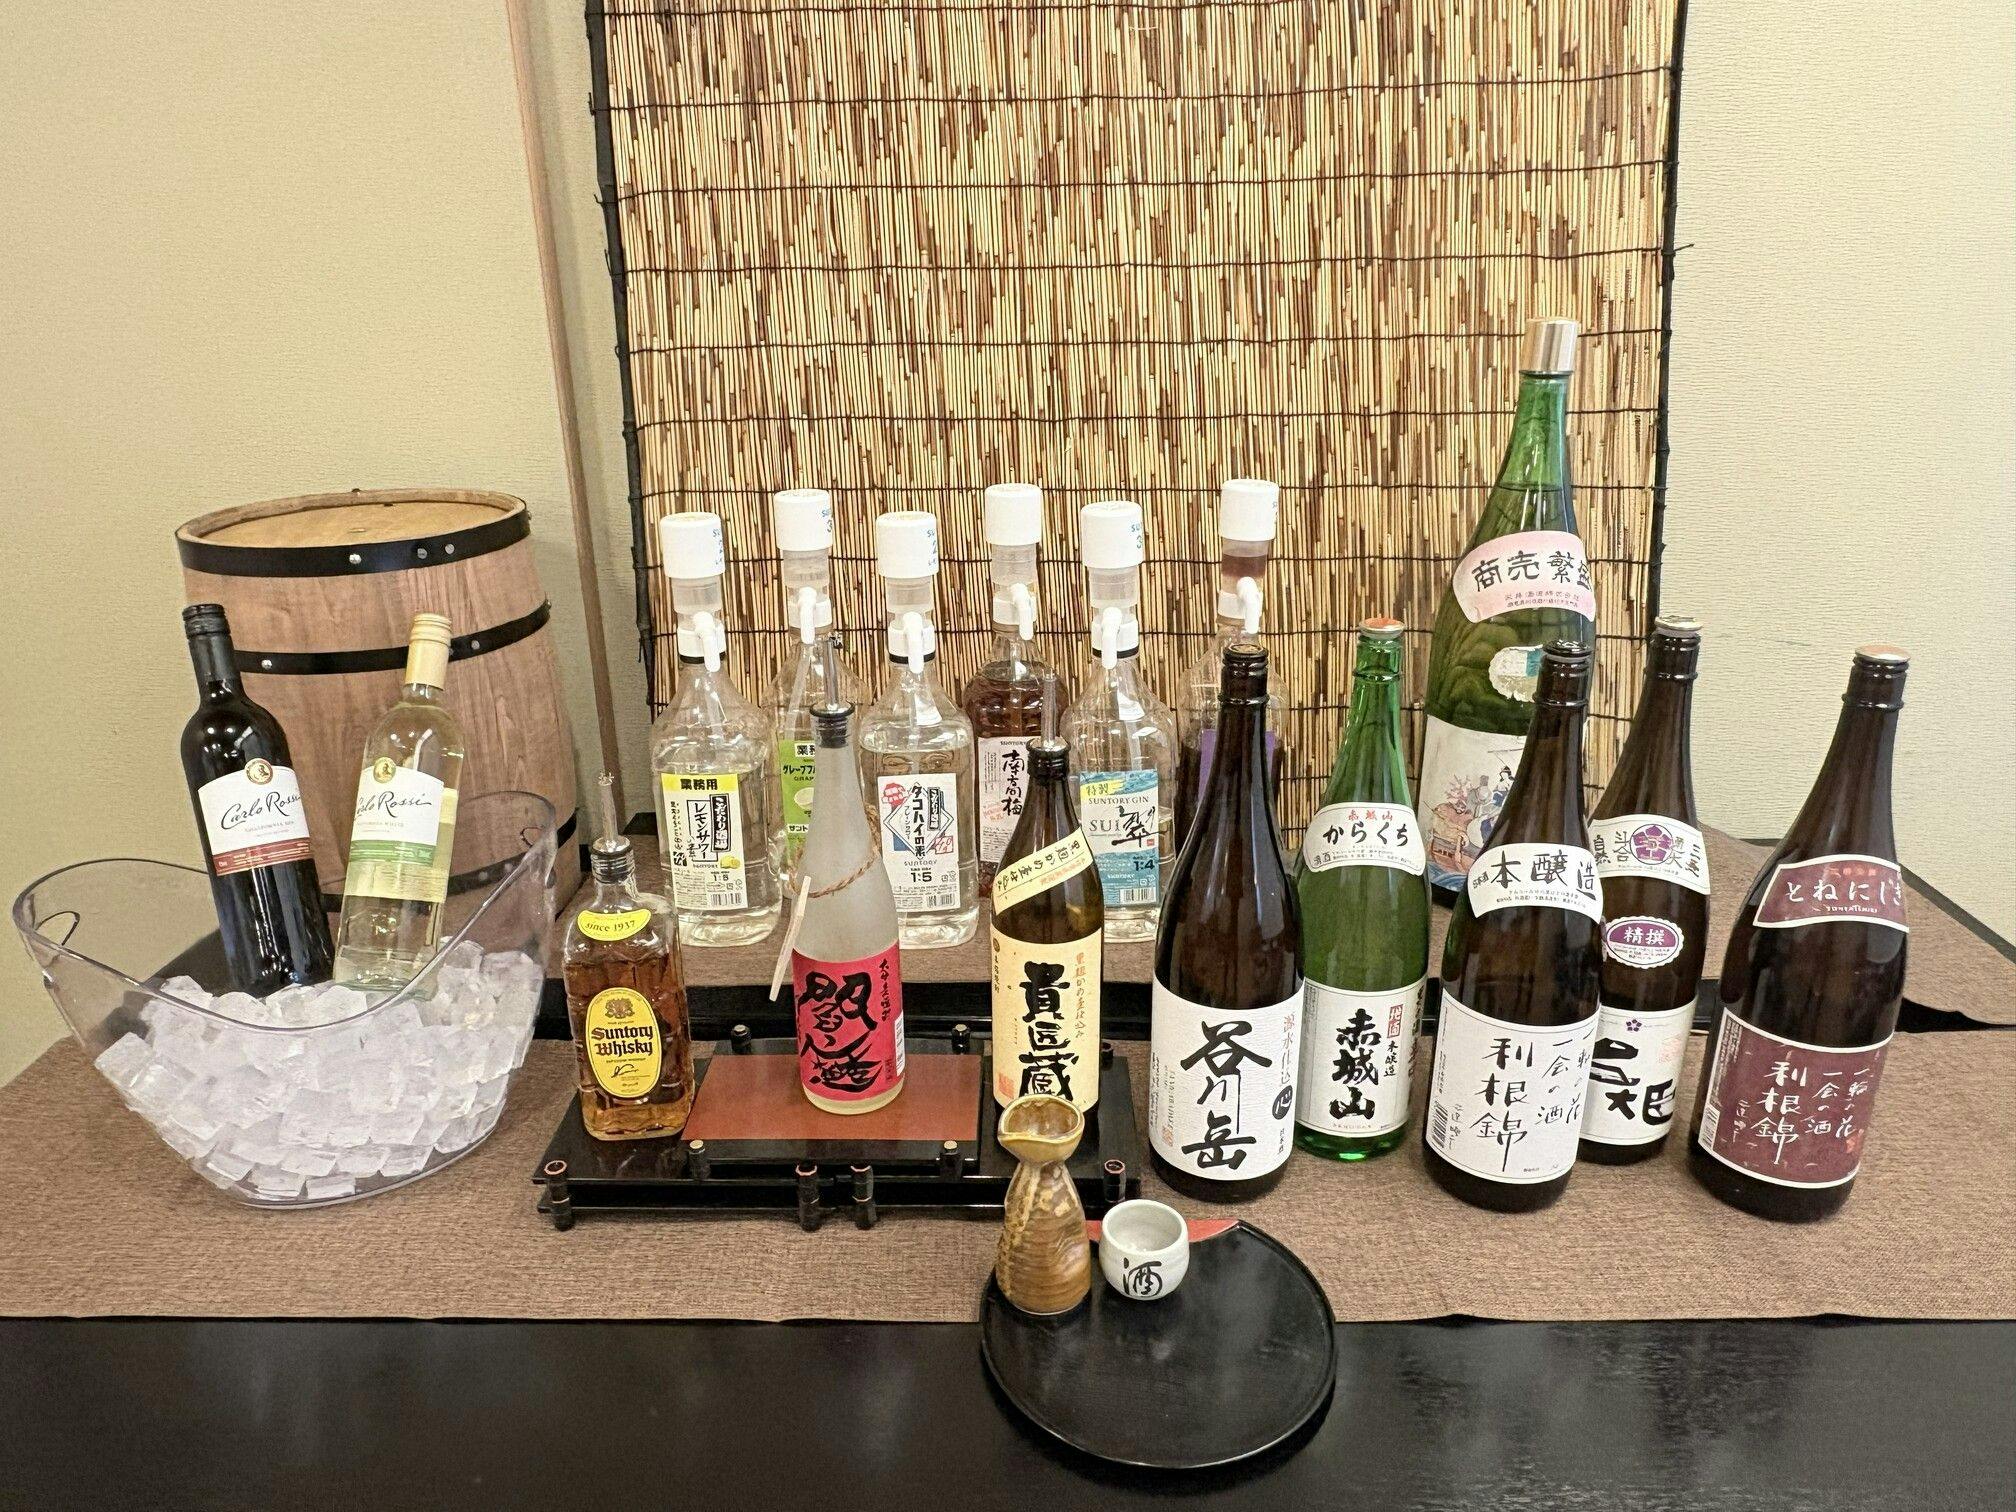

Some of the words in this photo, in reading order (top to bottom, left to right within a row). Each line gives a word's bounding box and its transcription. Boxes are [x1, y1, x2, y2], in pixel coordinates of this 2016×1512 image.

[680, 779, 718, 790] 業務用
[1001, 750, 1025, 816] 南高梅
[221, 799, 263, 830] Carlo
[266, 791, 300, 816] Rossi
[377, 790, 432, 818] Rossi
[1132, 796, 1149, 804] GIN
[695, 803, 710, 859] レモンサワー
[912, 785, 925, 857] タコハイの素
[1322, 821, 1408, 847] からくち
[911, 872, 932, 883] 1:5
[1134, 860, 1155, 871] 1:4
[1491, 849, 1597, 901] 本醸造
[585, 922, 610, 932] since
[613, 920, 636, 932] 1937
[1624, 927, 1665, 946] 精撰
[591, 1025, 653, 1040] Suntory
[594, 1041, 653, 1057] Whisky
[1329, 1008, 1381, 1119] 赤城山
[1180, 1020, 1272, 1170] 谷川岳
[1470, 1038, 1533, 1172] 利根錦
[1751, 1061, 1807, 1165] 利根錦
[1123, 1257, 1162, 1298] 酒
